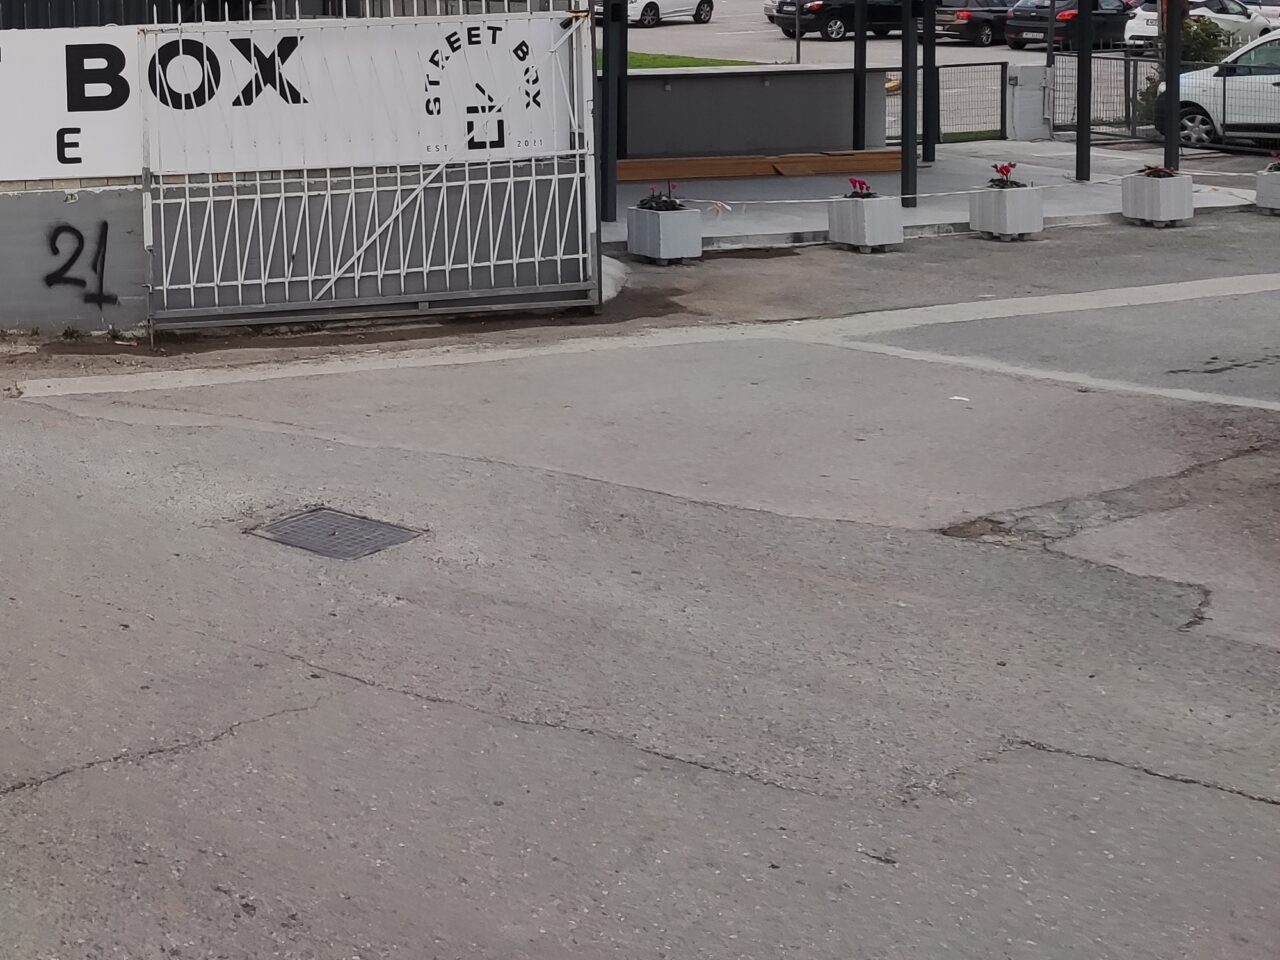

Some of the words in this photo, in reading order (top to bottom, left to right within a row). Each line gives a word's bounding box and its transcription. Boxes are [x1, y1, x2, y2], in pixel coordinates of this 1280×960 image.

[66, 35, 308, 113] BOX
[425, 25, 503, 115] STREET
[512, 40, 541, 109] BOX
[426, 144, 448, 152] EST
[43, 220, 119, 310] 21
